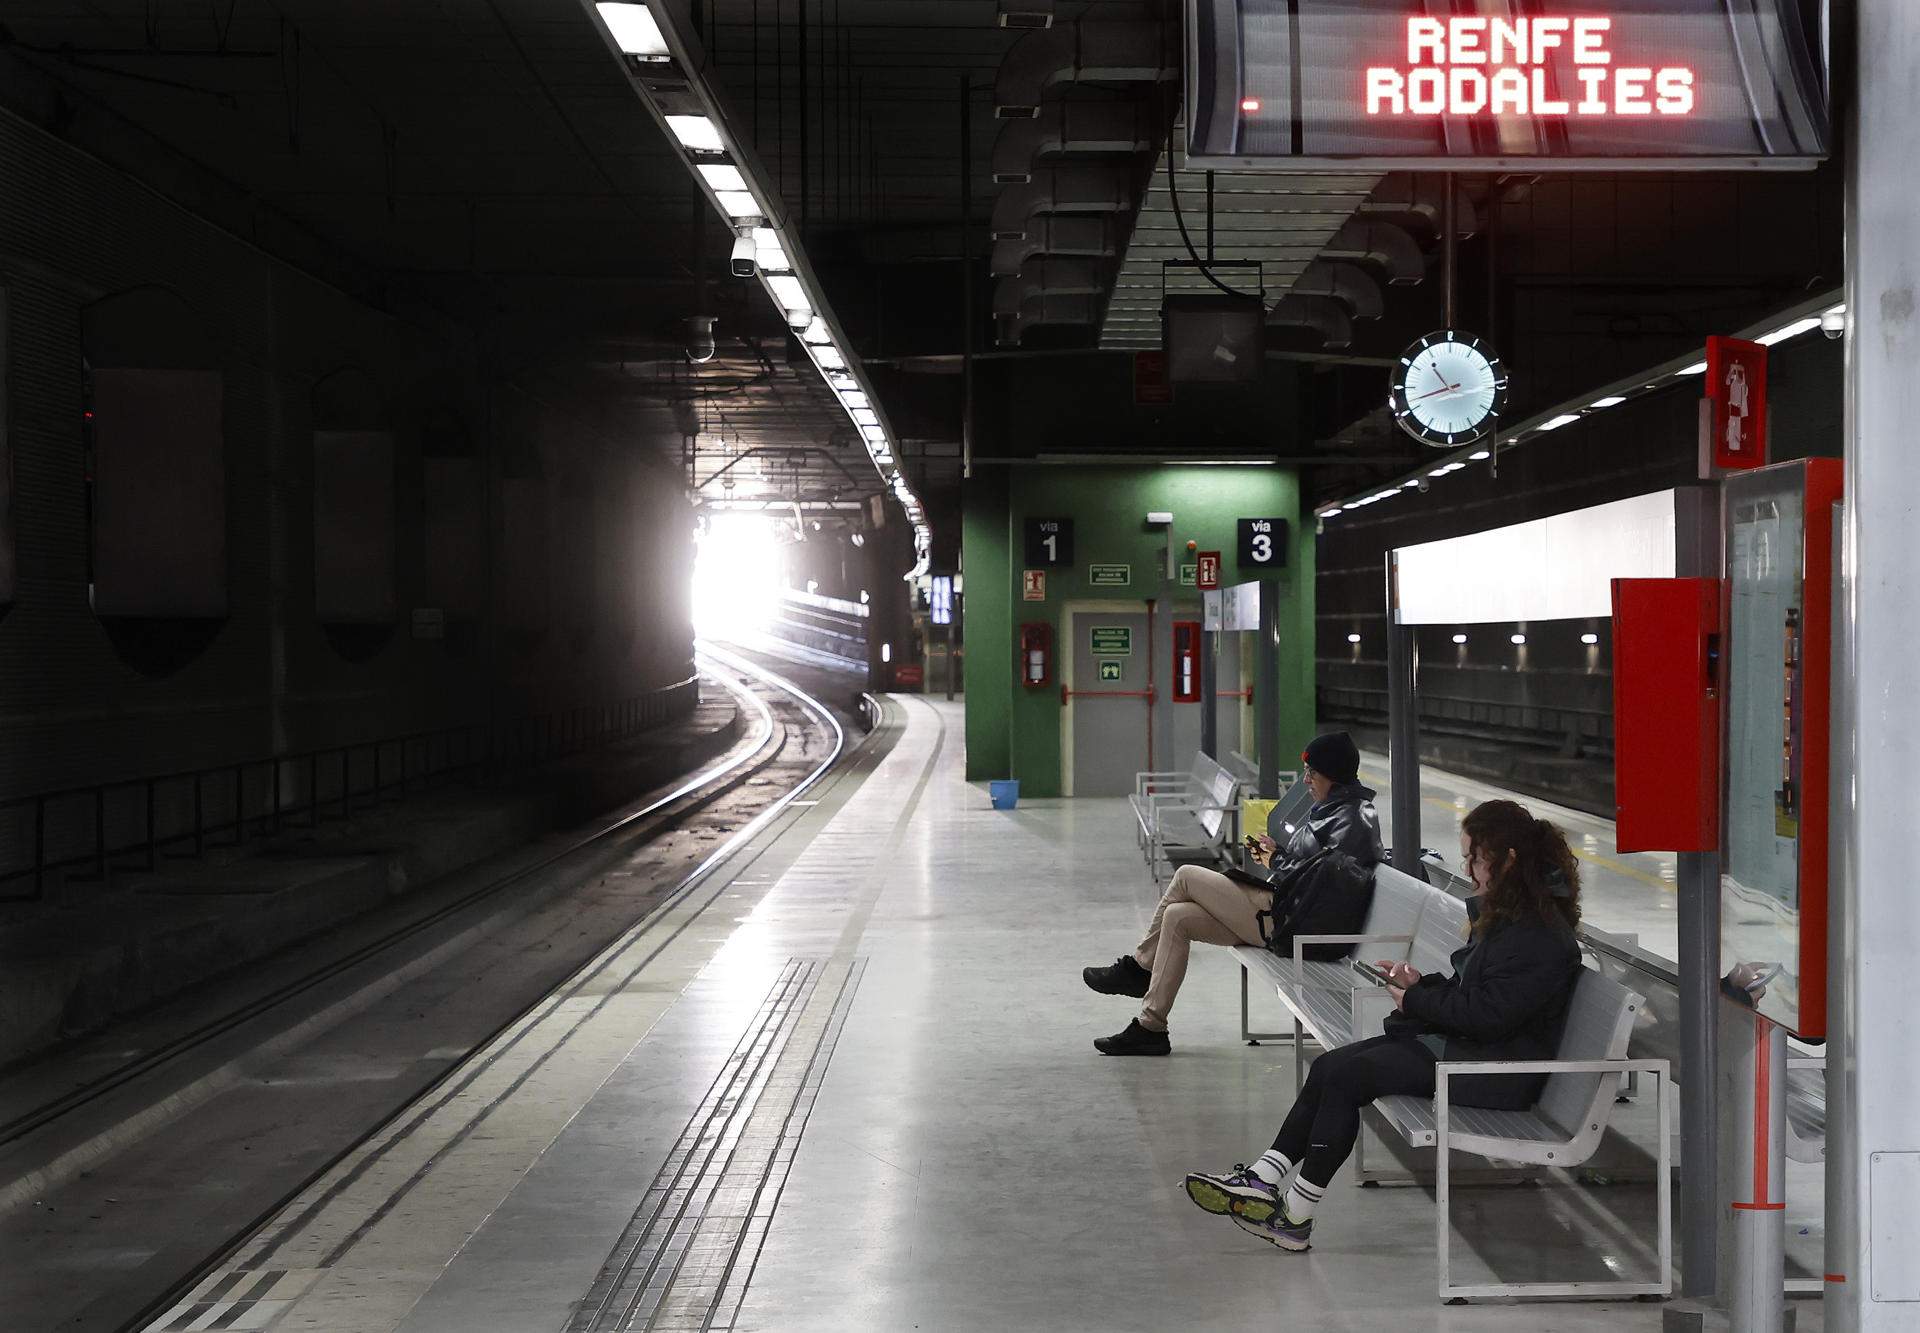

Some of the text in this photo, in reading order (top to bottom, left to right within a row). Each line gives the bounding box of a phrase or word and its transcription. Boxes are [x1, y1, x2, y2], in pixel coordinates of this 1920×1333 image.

[1407, 17, 1611, 65] RENFE
[1366, 68, 1693, 115] RODALIES
[1039, 520, 1058, 532] via
[1251, 519, 1271, 532] via
[1042, 535, 1056, 562] 1
[1251, 534, 1272, 562] 3
